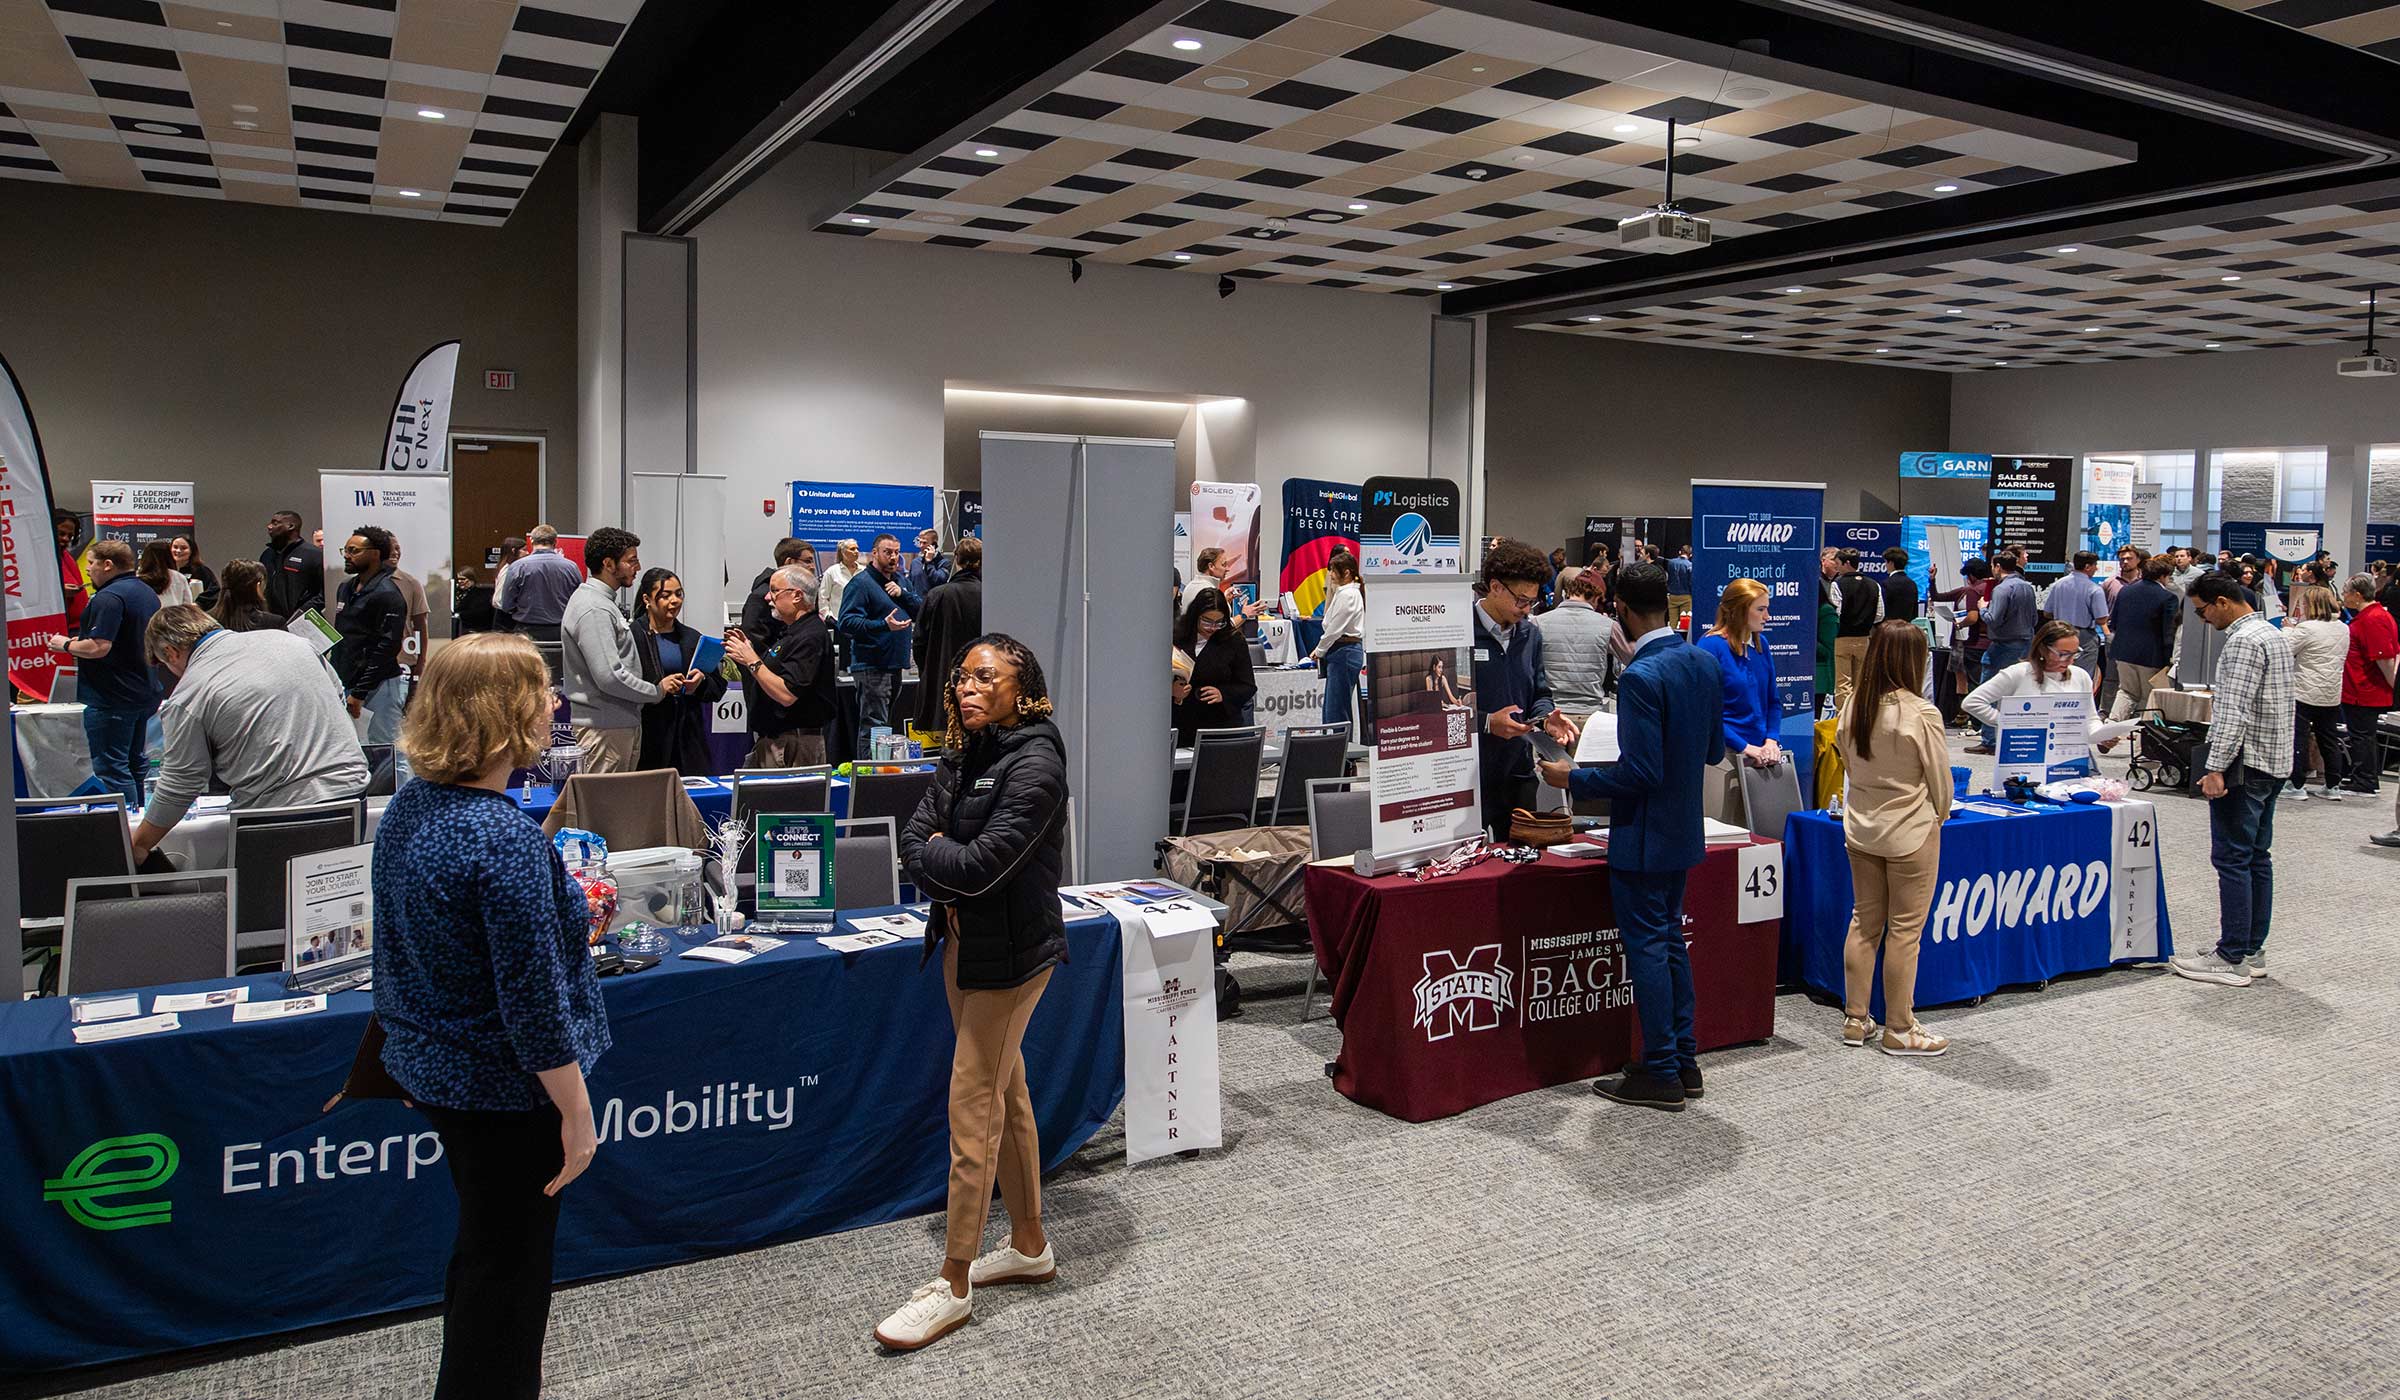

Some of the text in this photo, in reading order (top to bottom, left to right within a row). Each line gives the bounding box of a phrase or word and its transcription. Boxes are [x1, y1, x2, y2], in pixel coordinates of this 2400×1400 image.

[490, 372, 512, 388] EXIT
[1943, 460, 1992, 472] GARN
[1997, 481, 2056, 489] MARKETING
[354, 490, 375, 506] TVA
[808, 490, 831, 498] United
[1393, 492, 1449, 509] Logistics
[814, 508, 829, 516] you
[895, 509, 922, 518] future?
[1299, 519, 1338, 531] BEGIN
[1727, 523, 1793, 543] HOWARD
[2279, 536, 2305, 546] ambit
[1728, 563, 1786, 581] Be a part of
[1775, 581, 1799, 597] BIG!
[1395, 604, 1446, 615] ENGINEERING
[1272, 626, 1284, 637] 19
[717, 700, 744, 720] 60
[776, 833, 821, 842] CONNECT
[2127, 820, 2151, 848] 42
[306, 871, 358, 888] JOIN TO START
[1745, 864, 1778, 898] 43
[306, 885, 326, 896] YOUR
[1143, 903, 1193, 914] 44
[1932, 860, 2109, 944] HOWARD
[1530, 930, 1593, 951] MISSISSIPPI
[1568, 944, 1612, 961] JAMES
[1147, 987, 1197, 1004] MISSISSIPPI STATE
[1431, 974, 1493, 1007] STATE
[1529, 996, 1582, 1022] COLLEGE
[1585, 993, 1601, 1013] OF
[1167, 1014, 1178, 1140] PARTNER
